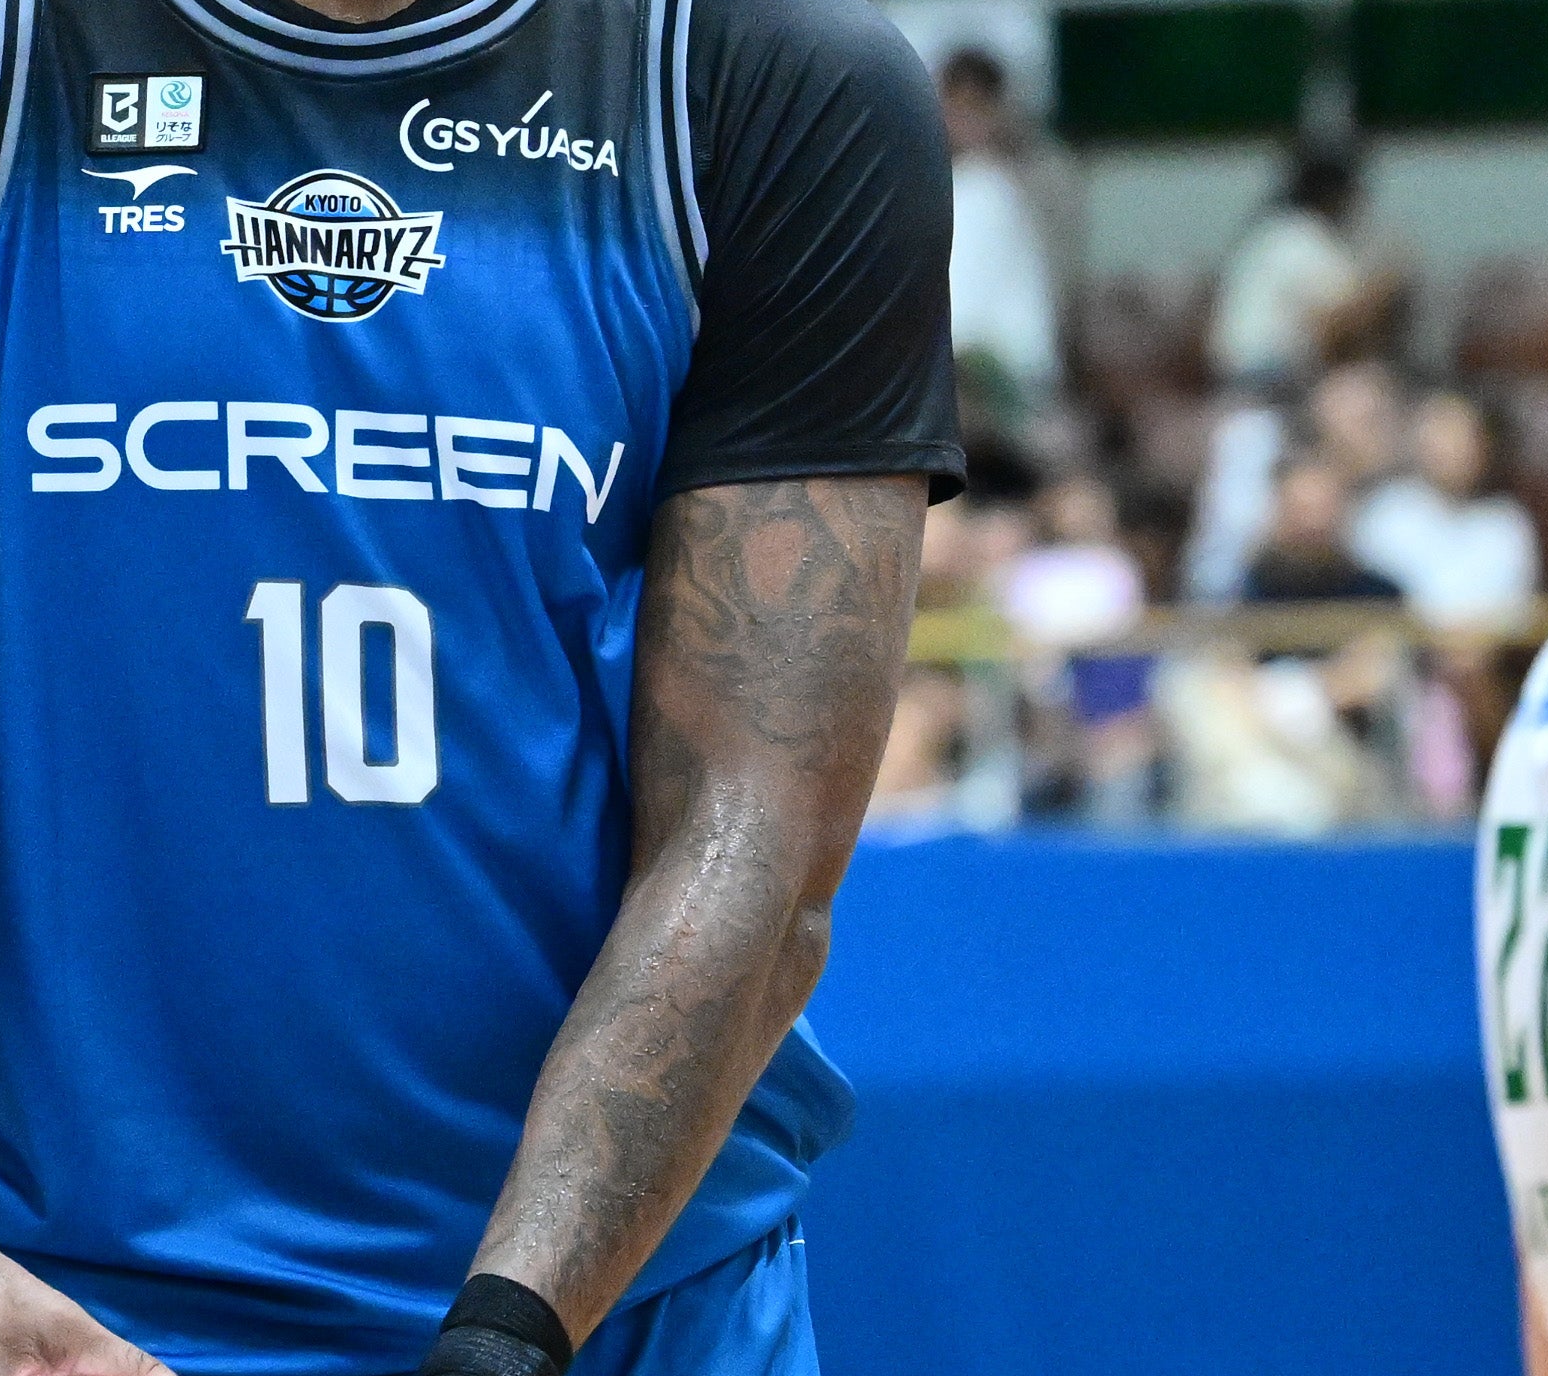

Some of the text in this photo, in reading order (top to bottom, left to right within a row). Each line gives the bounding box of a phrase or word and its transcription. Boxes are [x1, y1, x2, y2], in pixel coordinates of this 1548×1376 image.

[100, 134, 138, 143] B.LEAGUE
[154, 132, 192, 143] グループ
[155, 121, 193, 133] りそな
[485, 90, 619, 177] YUASA
[304, 193, 362, 214] KYOTO
[98, 204, 185, 234] TRES
[224, 211, 442, 281] HANNARYZ
[28, 399, 626, 526] SCREEN
[244, 579, 440, 808] 10
